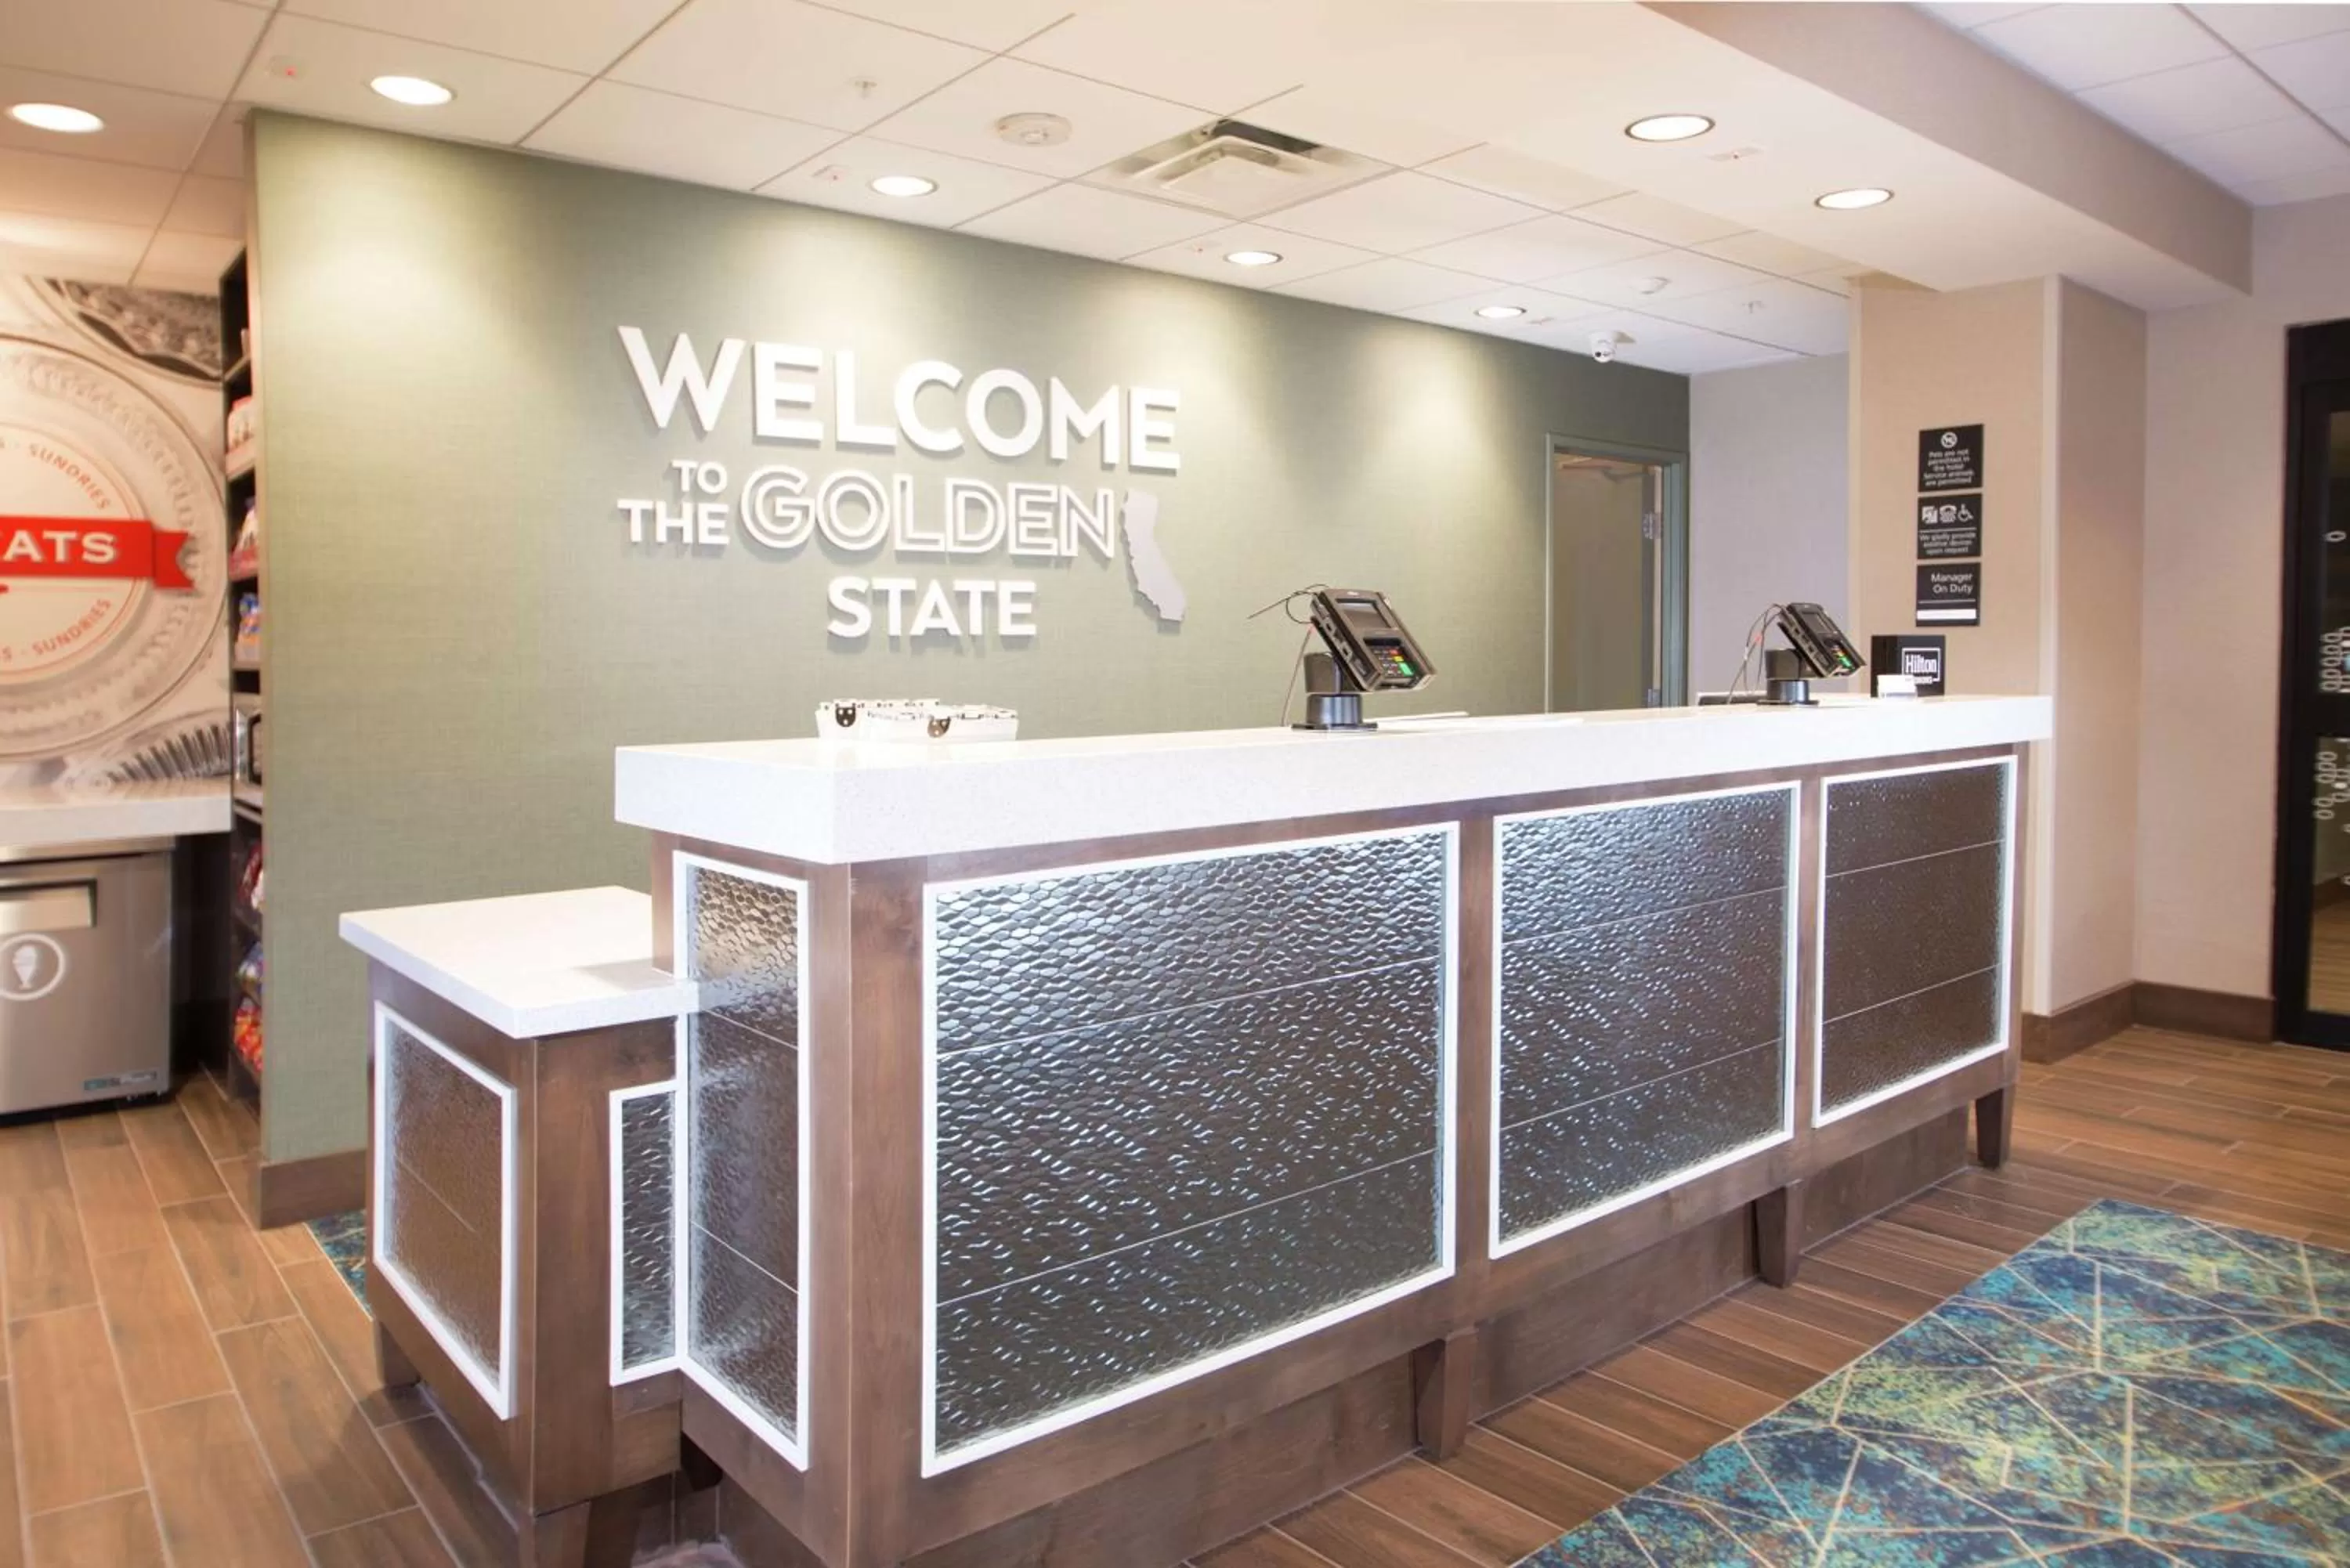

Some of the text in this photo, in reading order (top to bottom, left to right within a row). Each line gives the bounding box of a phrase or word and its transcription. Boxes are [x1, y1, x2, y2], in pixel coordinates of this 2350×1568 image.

[617, 325, 1180, 470] WELCOME
[29, 443, 111, 510] SUNDRIES
[671, 459, 728, 495] TO
[616, 464, 1115, 559] THE GOLDEN
[0, 529, 118, 565] ATS
[1931, 573, 1972, 583] Manager
[1932, 583, 1973, 595] On Duty
[32, 598, 111, 656] SUNDRIES
[826, 576, 1037, 638] STATE
[1905, 654, 1937, 673] Hilton
